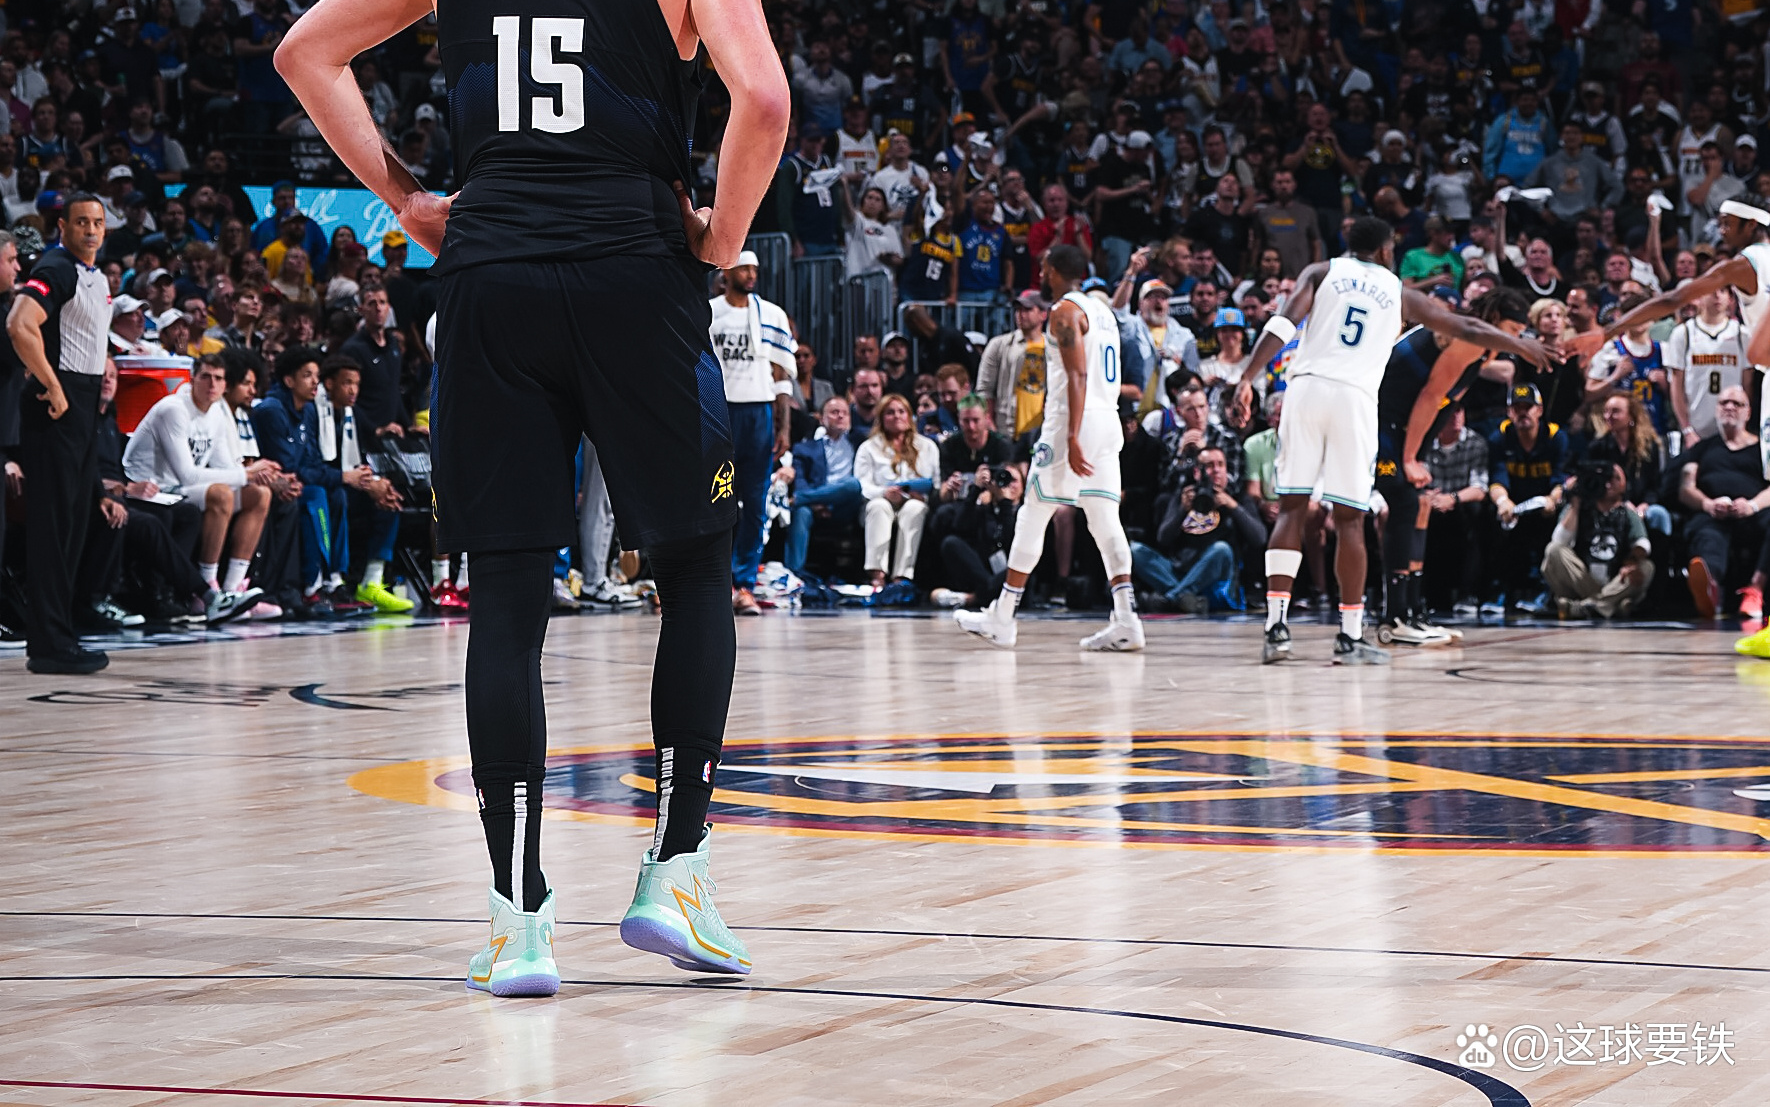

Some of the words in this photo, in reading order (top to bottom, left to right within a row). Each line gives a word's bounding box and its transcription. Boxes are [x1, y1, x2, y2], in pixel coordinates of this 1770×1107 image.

[493, 15, 586, 133] 15
[1332, 278, 1395, 310] EDWARDS
[1340, 305, 1368, 347] 5
